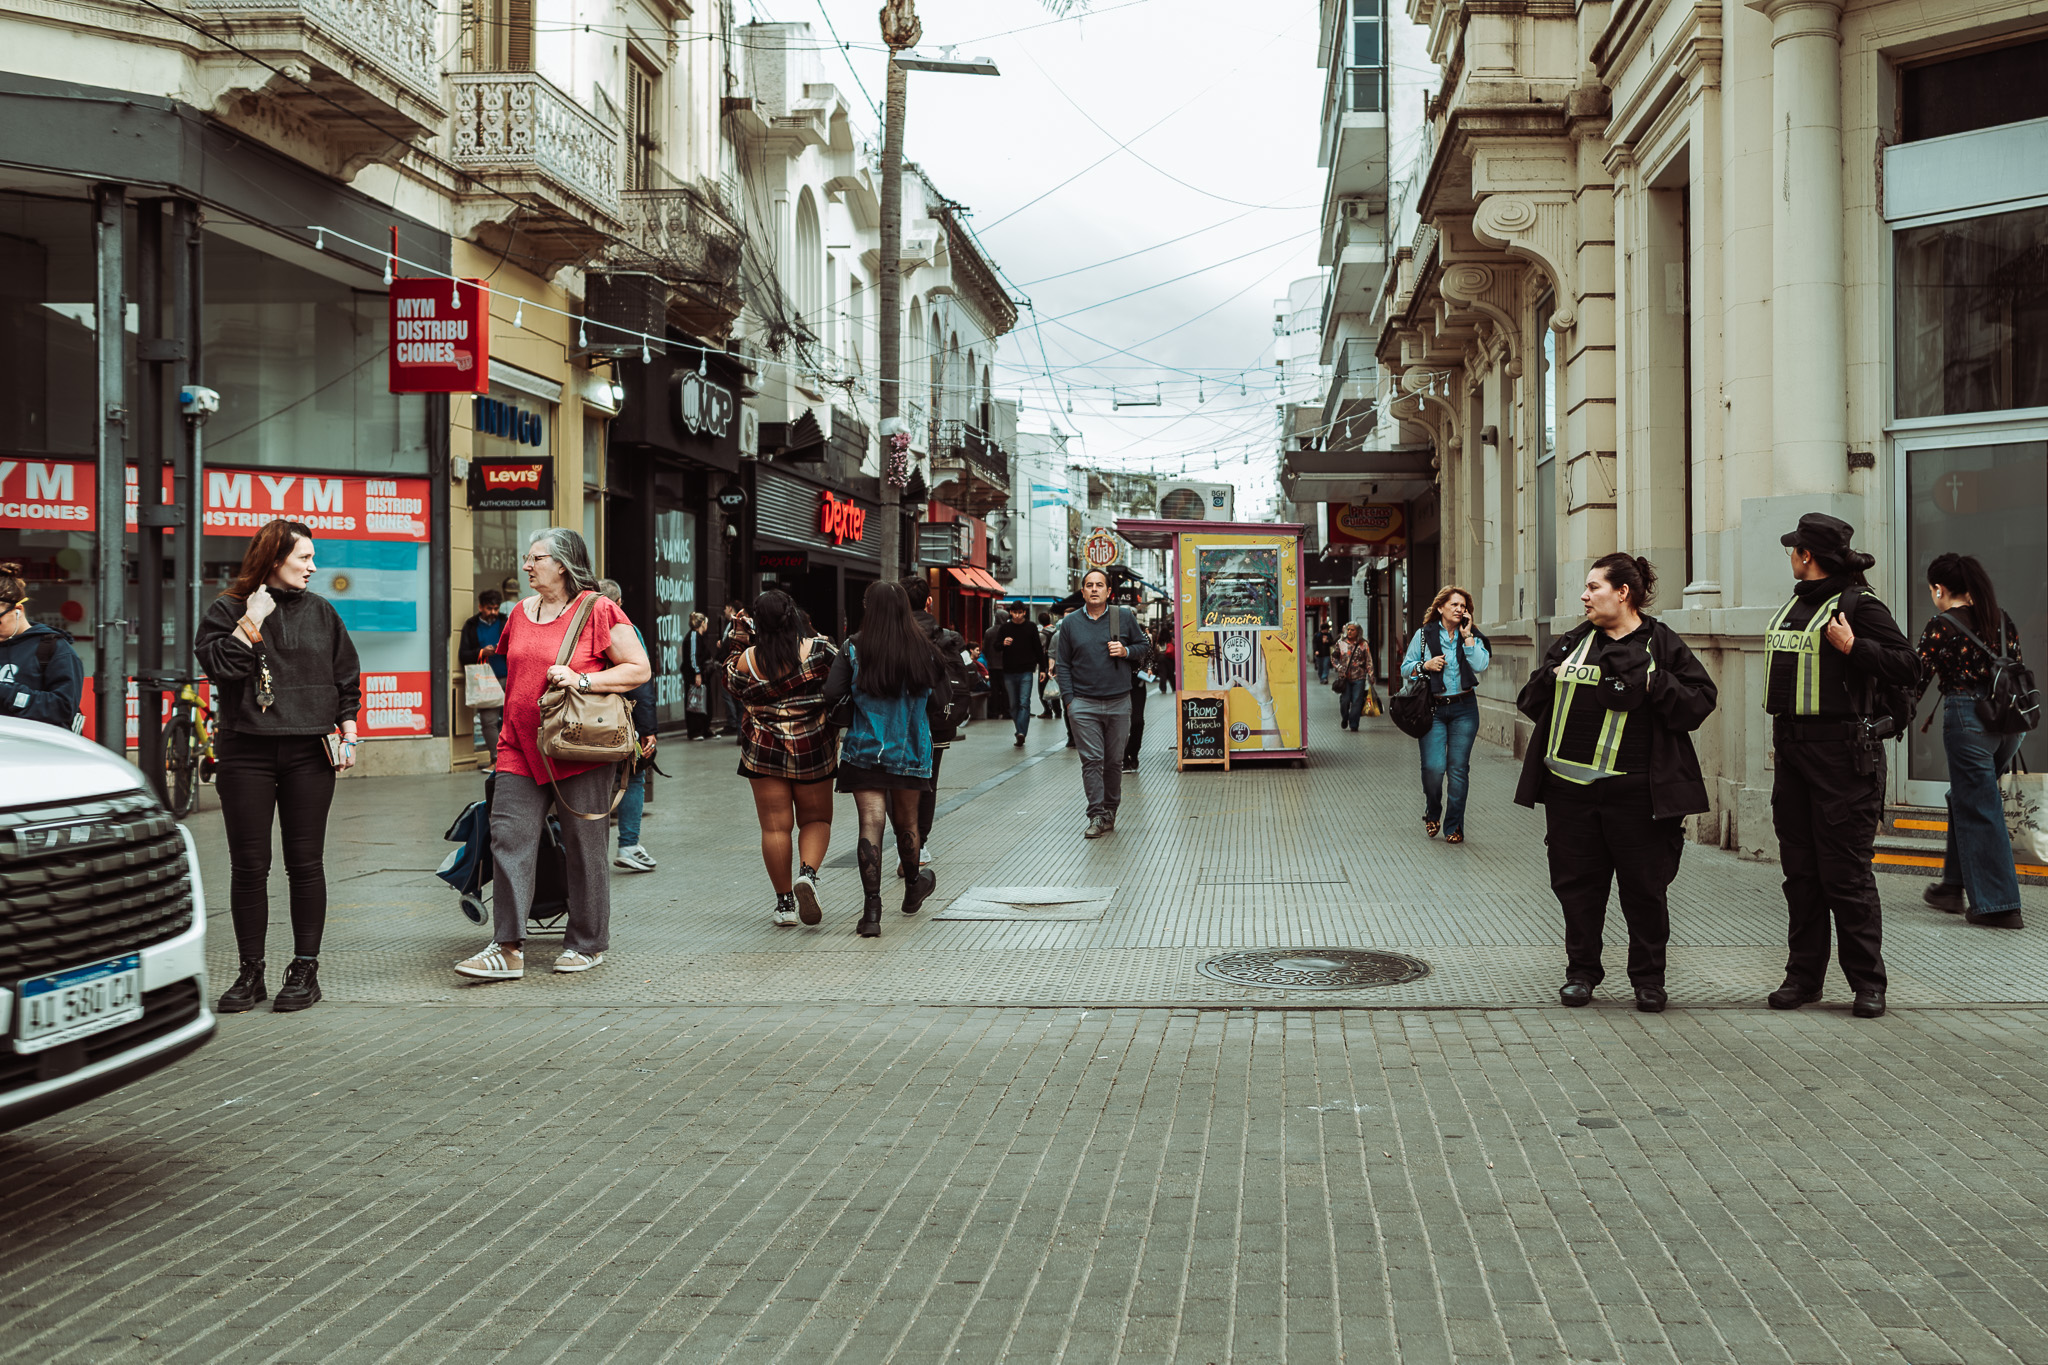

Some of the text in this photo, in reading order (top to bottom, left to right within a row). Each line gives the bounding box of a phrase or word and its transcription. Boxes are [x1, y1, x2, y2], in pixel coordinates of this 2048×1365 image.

[397, 298, 436, 319] MYM
[397, 320, 469, 341] DISTRIBU
[397, 342, 456, 363] CIONES
[699, 380, 734, 438] VCP
[476, 395, 543, 447] INDIGO
[208, 472, 344, 513] MYM
[366, 480, 397, 497] MYM
[366, 497, 422, 515] DISTRIBU
[720, 495, 743, 504] VCP
[821, 490, 866, 545] Dexter
[1351, 506, 1391, 517] PRECIOS
[366, 513, 412, 530] CIONES
[1342, 516, 1388, 527] CUIDADOS
[663, 538, 690, 564] VAMOS
[760, 555, 804, 567] Dexter
[656, 614, 683, 642] TOTAL
[1227, 638, 1247, 648] SWEET
[1767, 634, 1813, 651] POLICIA
[663, 645, 678, 674] POR
[366, 675, 397, 692] MYM
[366, 692, 422, 709] DISTRIBU
[366, 708, 412, 725] CIONES
